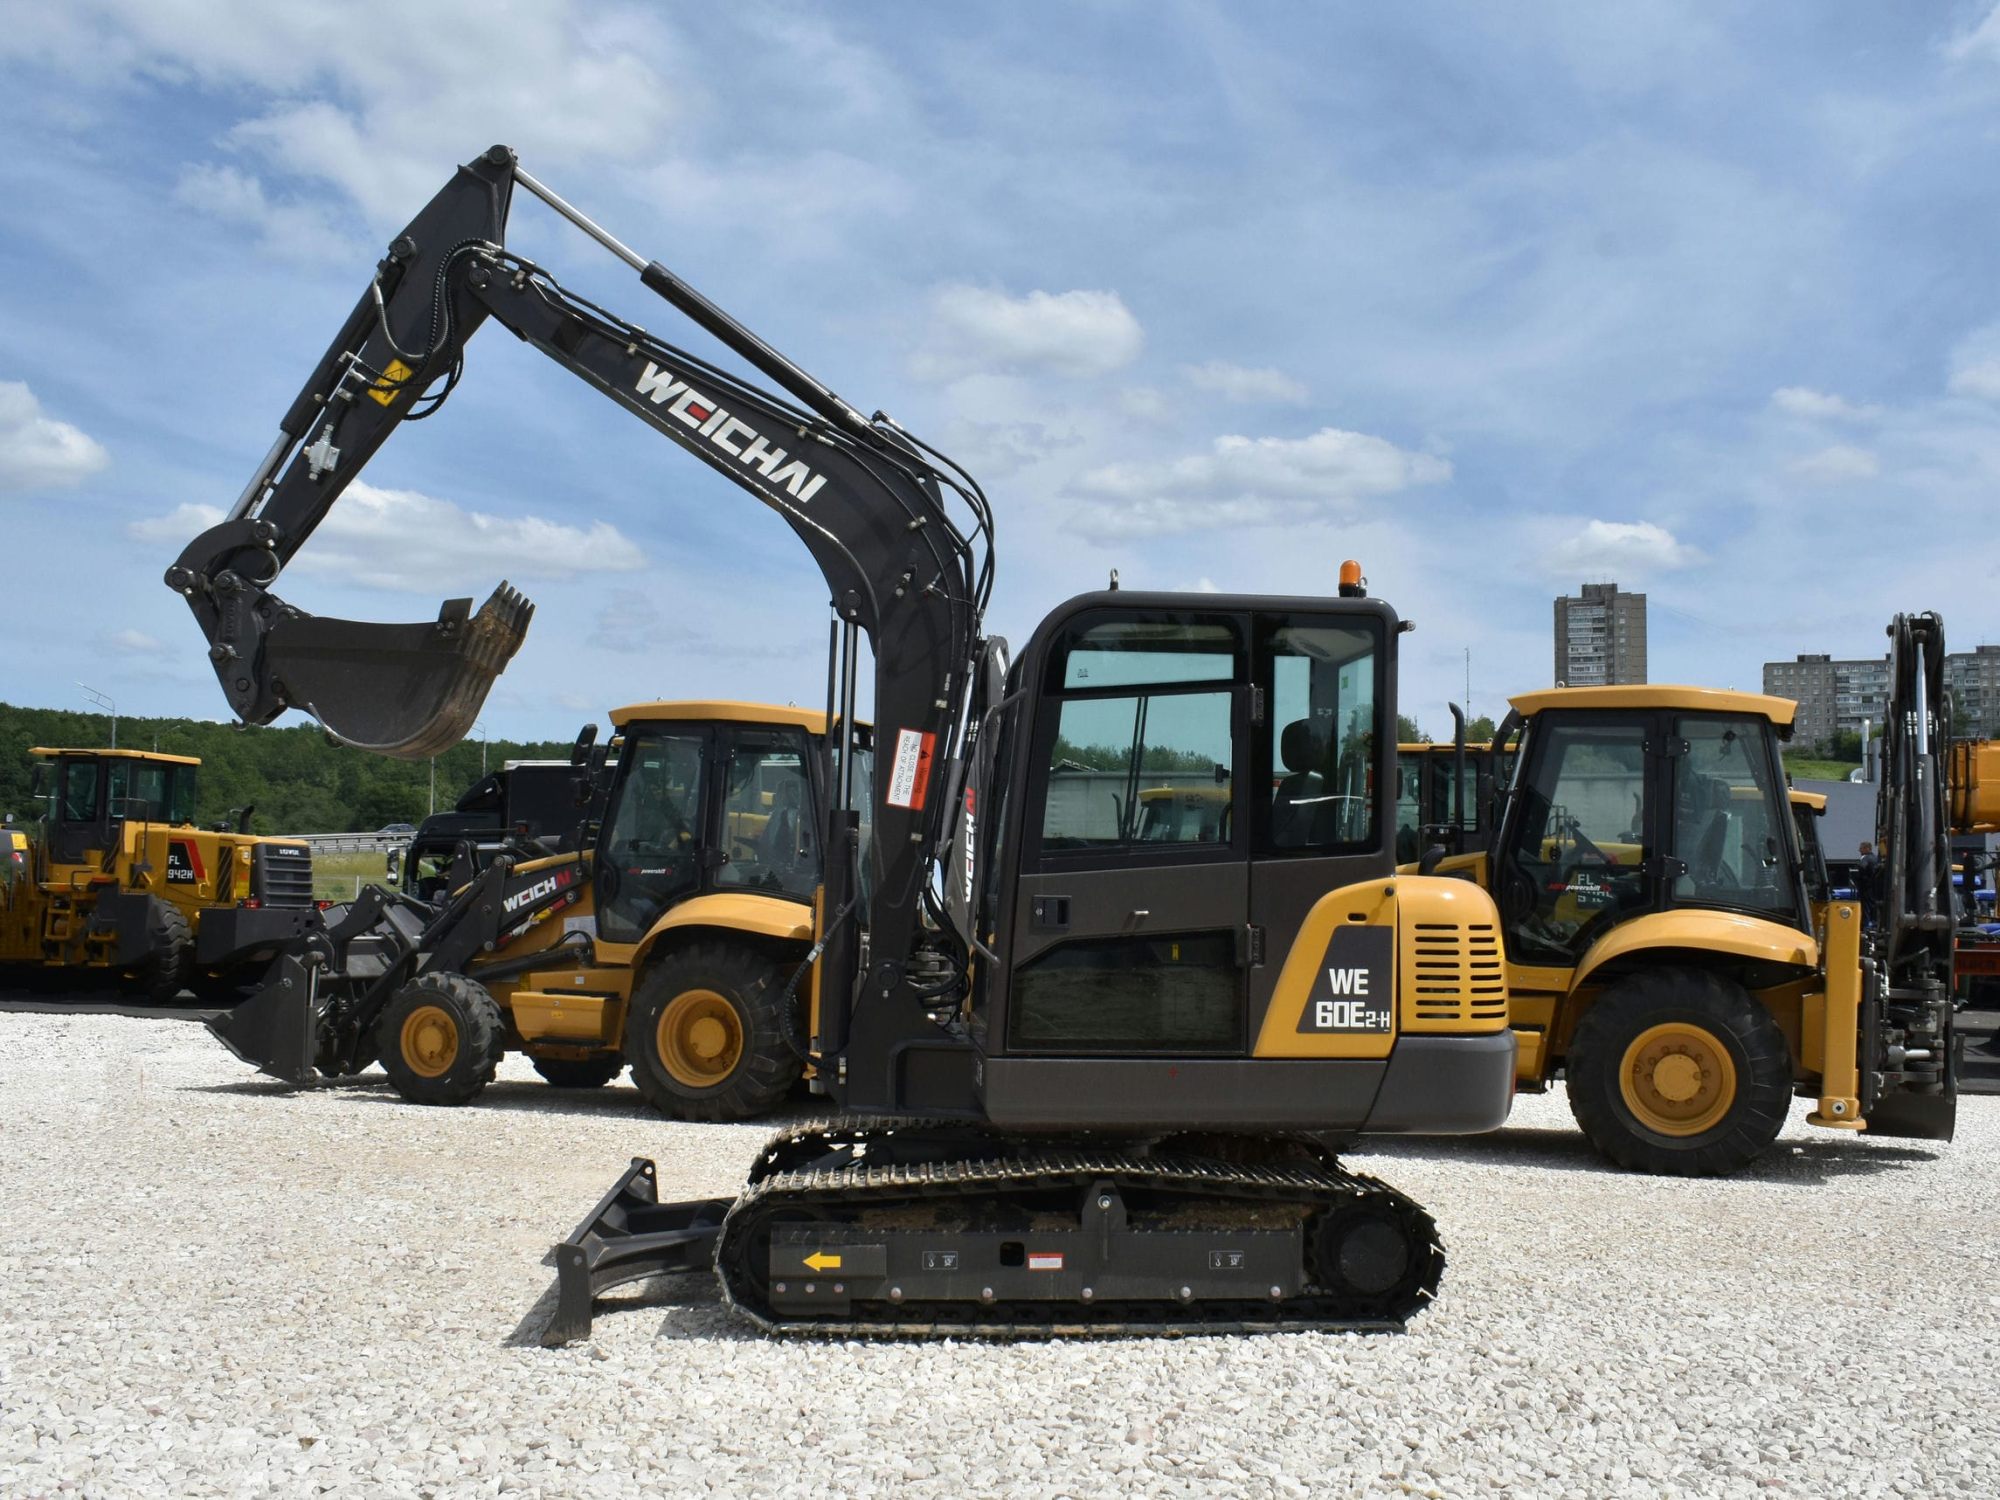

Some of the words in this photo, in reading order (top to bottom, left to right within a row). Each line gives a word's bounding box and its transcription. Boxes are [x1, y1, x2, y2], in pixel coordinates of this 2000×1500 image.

[635, 361, 828, 503] WEICHAI
[168, 855, 180, 865] FL
[168, 869, 194, 879] 942H
[1577, 873, 1594, 885] FL
[1329, 968, 1369, 995] WE
